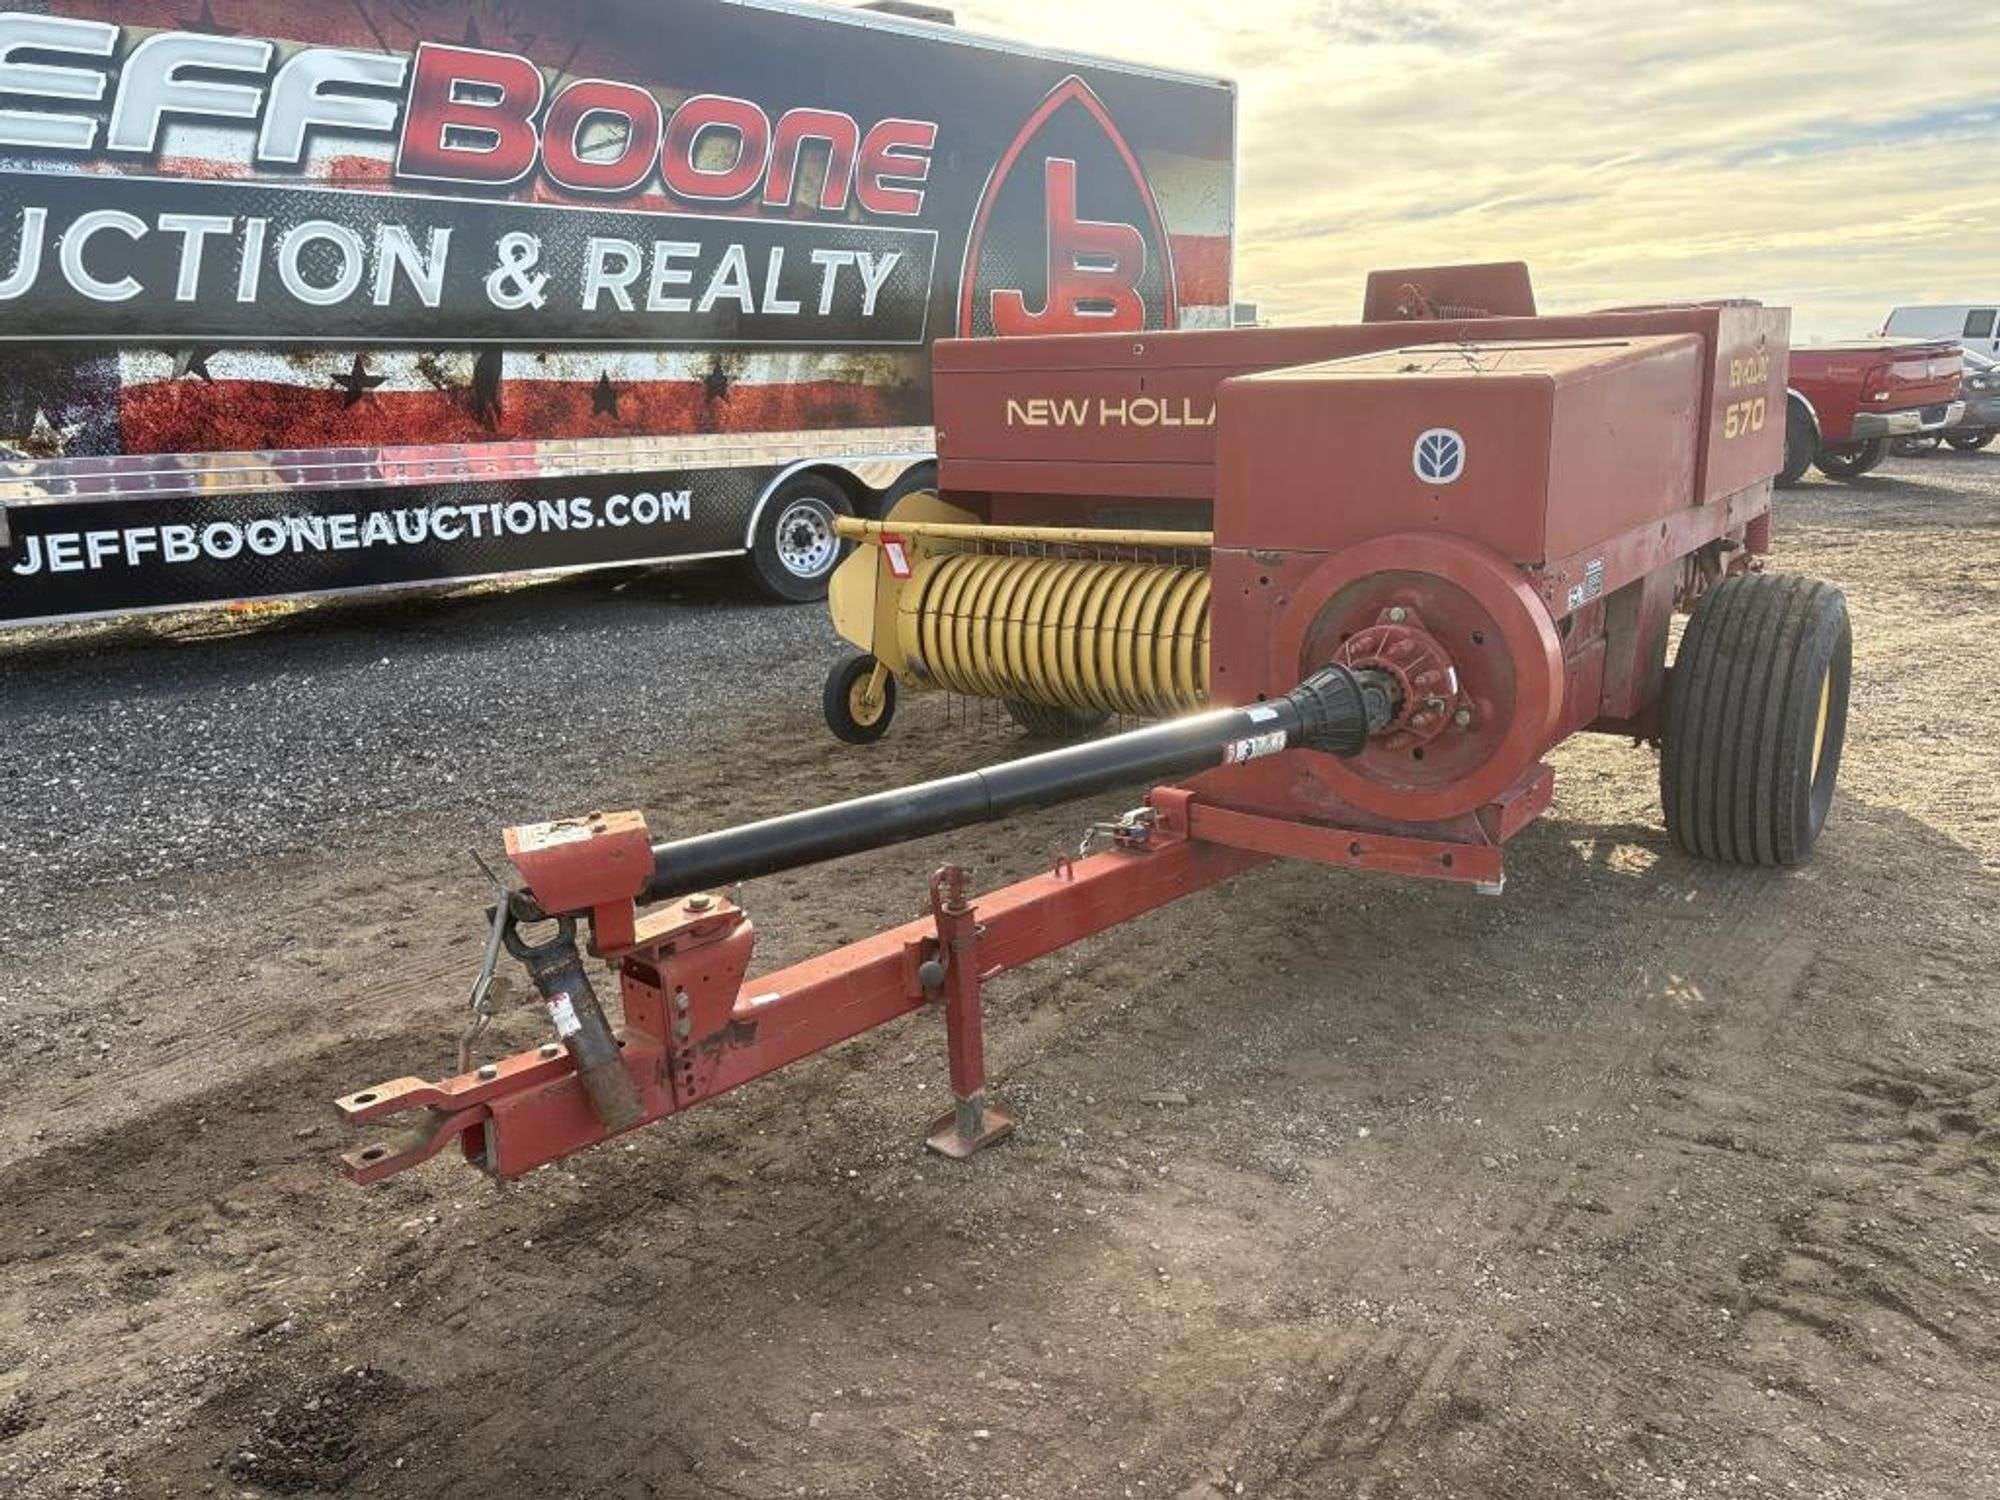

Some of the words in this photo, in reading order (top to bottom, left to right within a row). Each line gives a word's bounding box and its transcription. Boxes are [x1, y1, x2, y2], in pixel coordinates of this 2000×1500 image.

[485, 231, 547, 311] &
[582, 236, 902, 317] REALTY
[990, 156, 1146, 334] JB
[1007, 398, 1090, 427] NEW
[1724, 397, 1765, 439] 570
[13, 489, 692, 575] JEFFBOONEAUCTIONS.COM
